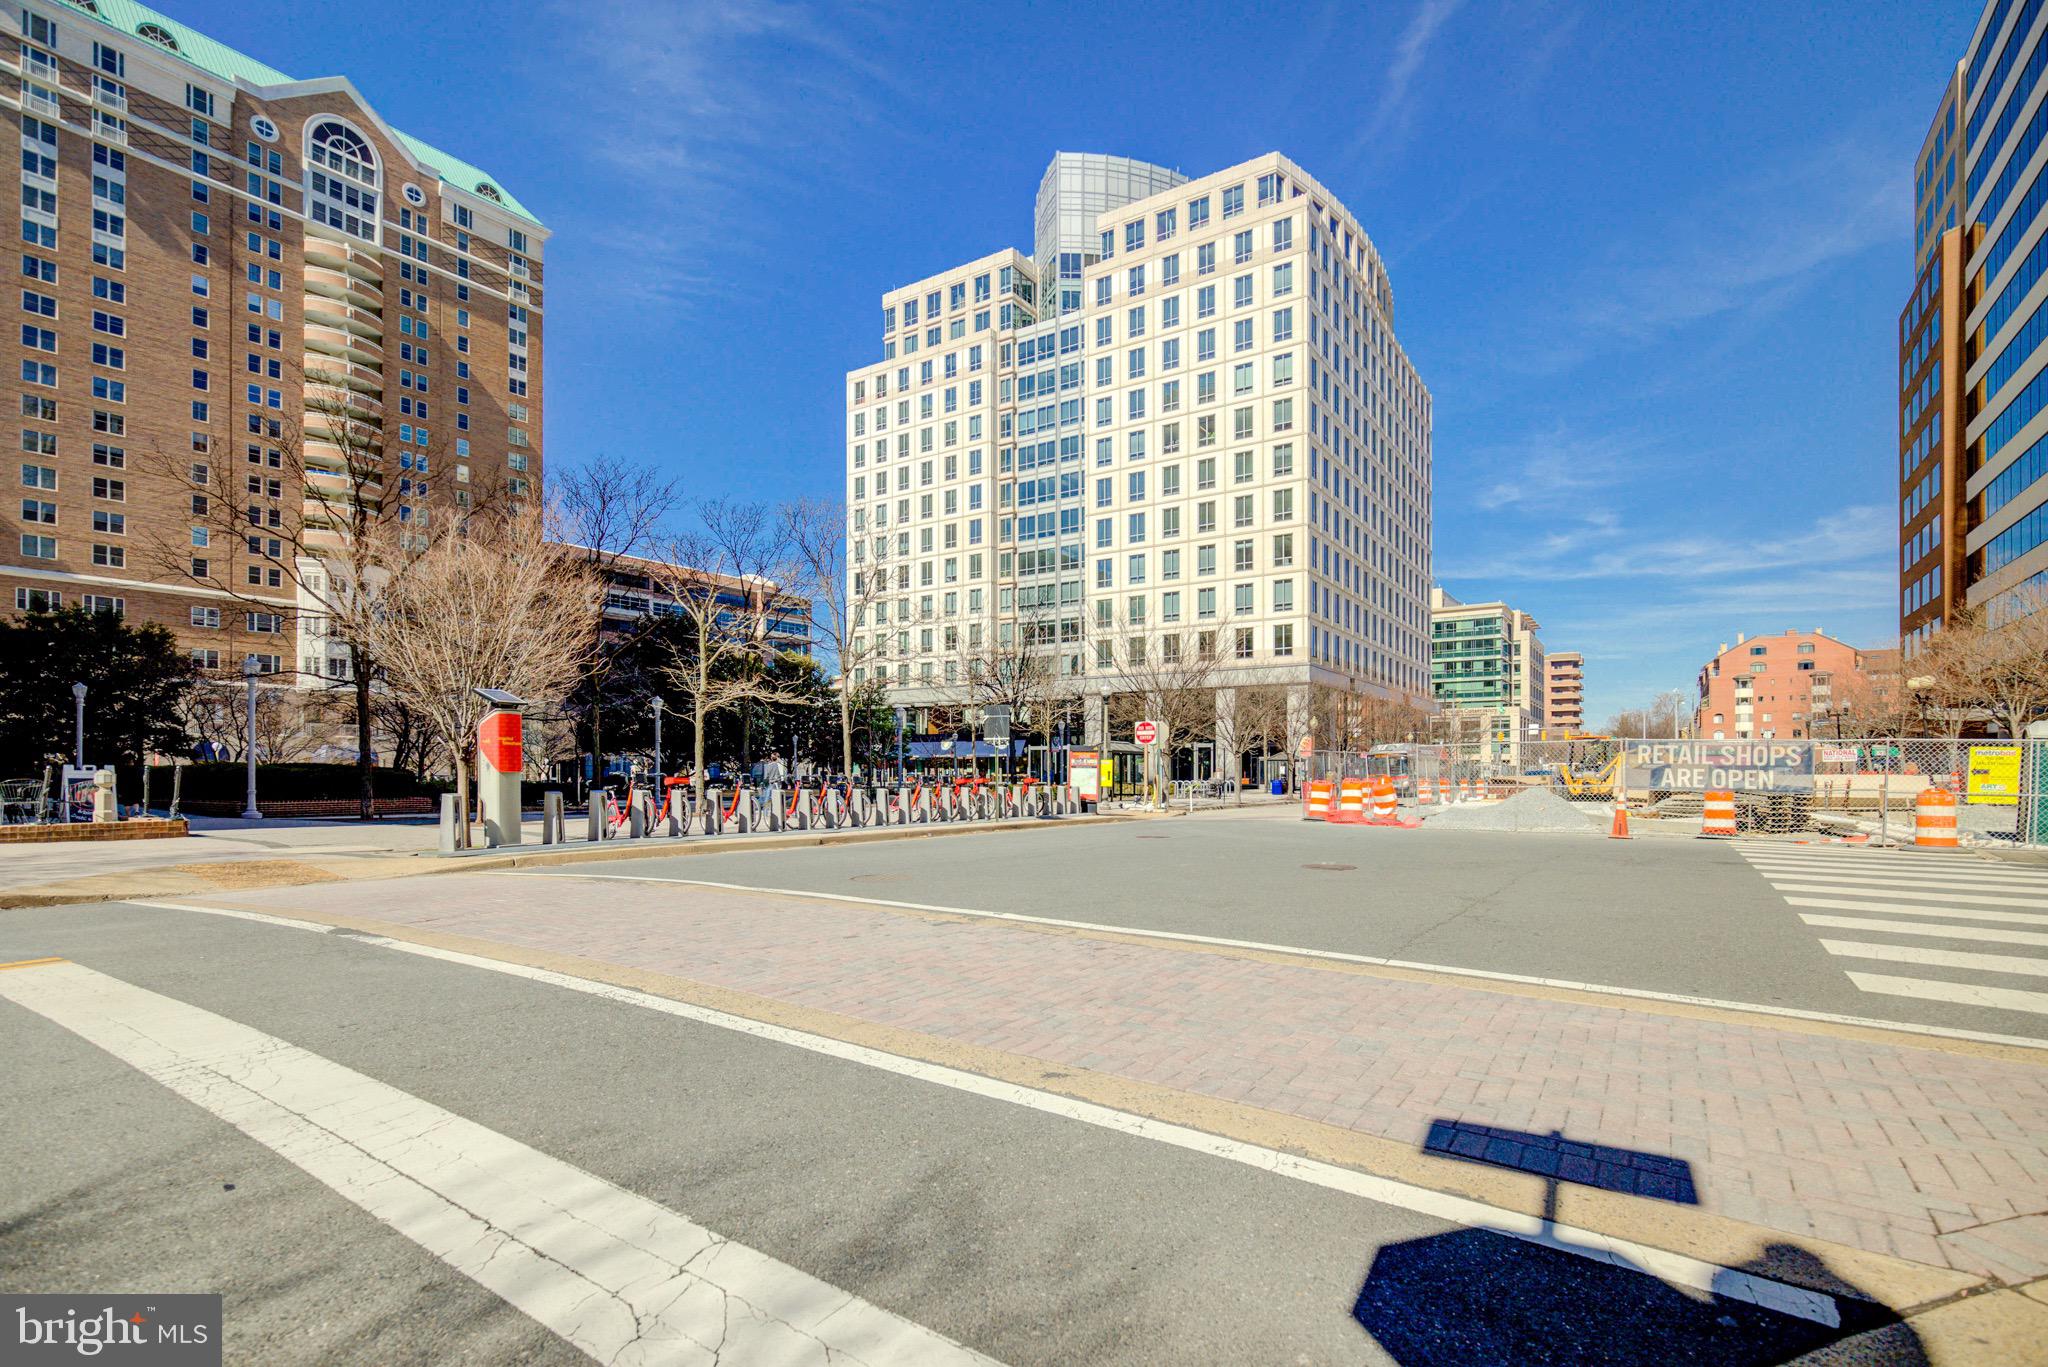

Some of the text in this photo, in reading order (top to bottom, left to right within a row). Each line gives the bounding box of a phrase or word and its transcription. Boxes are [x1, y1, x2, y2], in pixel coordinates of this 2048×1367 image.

[1637, 744, 1802, 767] RETAIL SHOPS
[1660, 768, 1775, 790] ARE OPEN
